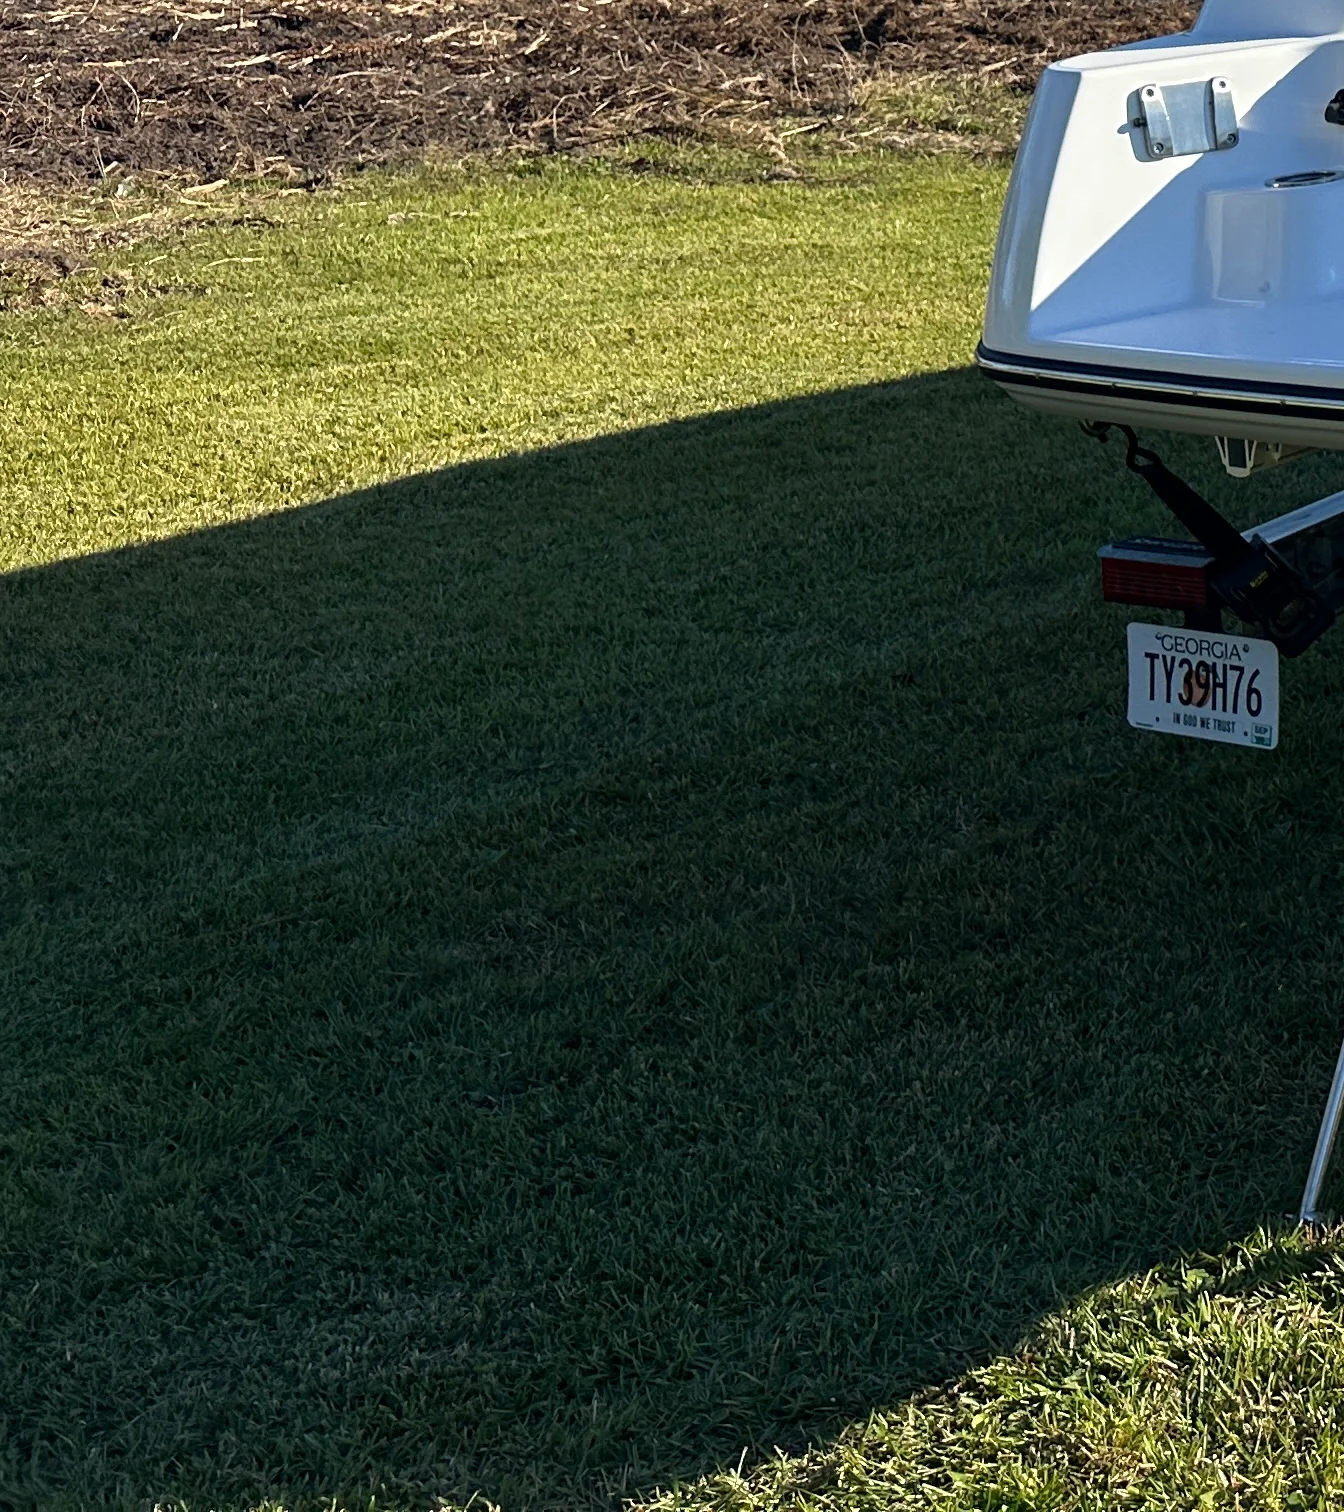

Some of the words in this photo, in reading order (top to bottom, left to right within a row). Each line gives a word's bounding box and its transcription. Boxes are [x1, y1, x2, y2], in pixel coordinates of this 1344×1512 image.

[1161, 633, 1242, 661] GEORGIA
[1144, 651, 1263, 717] TY39H76
[1172, 712, 1181, 725] IN
[1199, 716, 1210, 730] WE
[1213, 719, 1236, 733] TRUST
